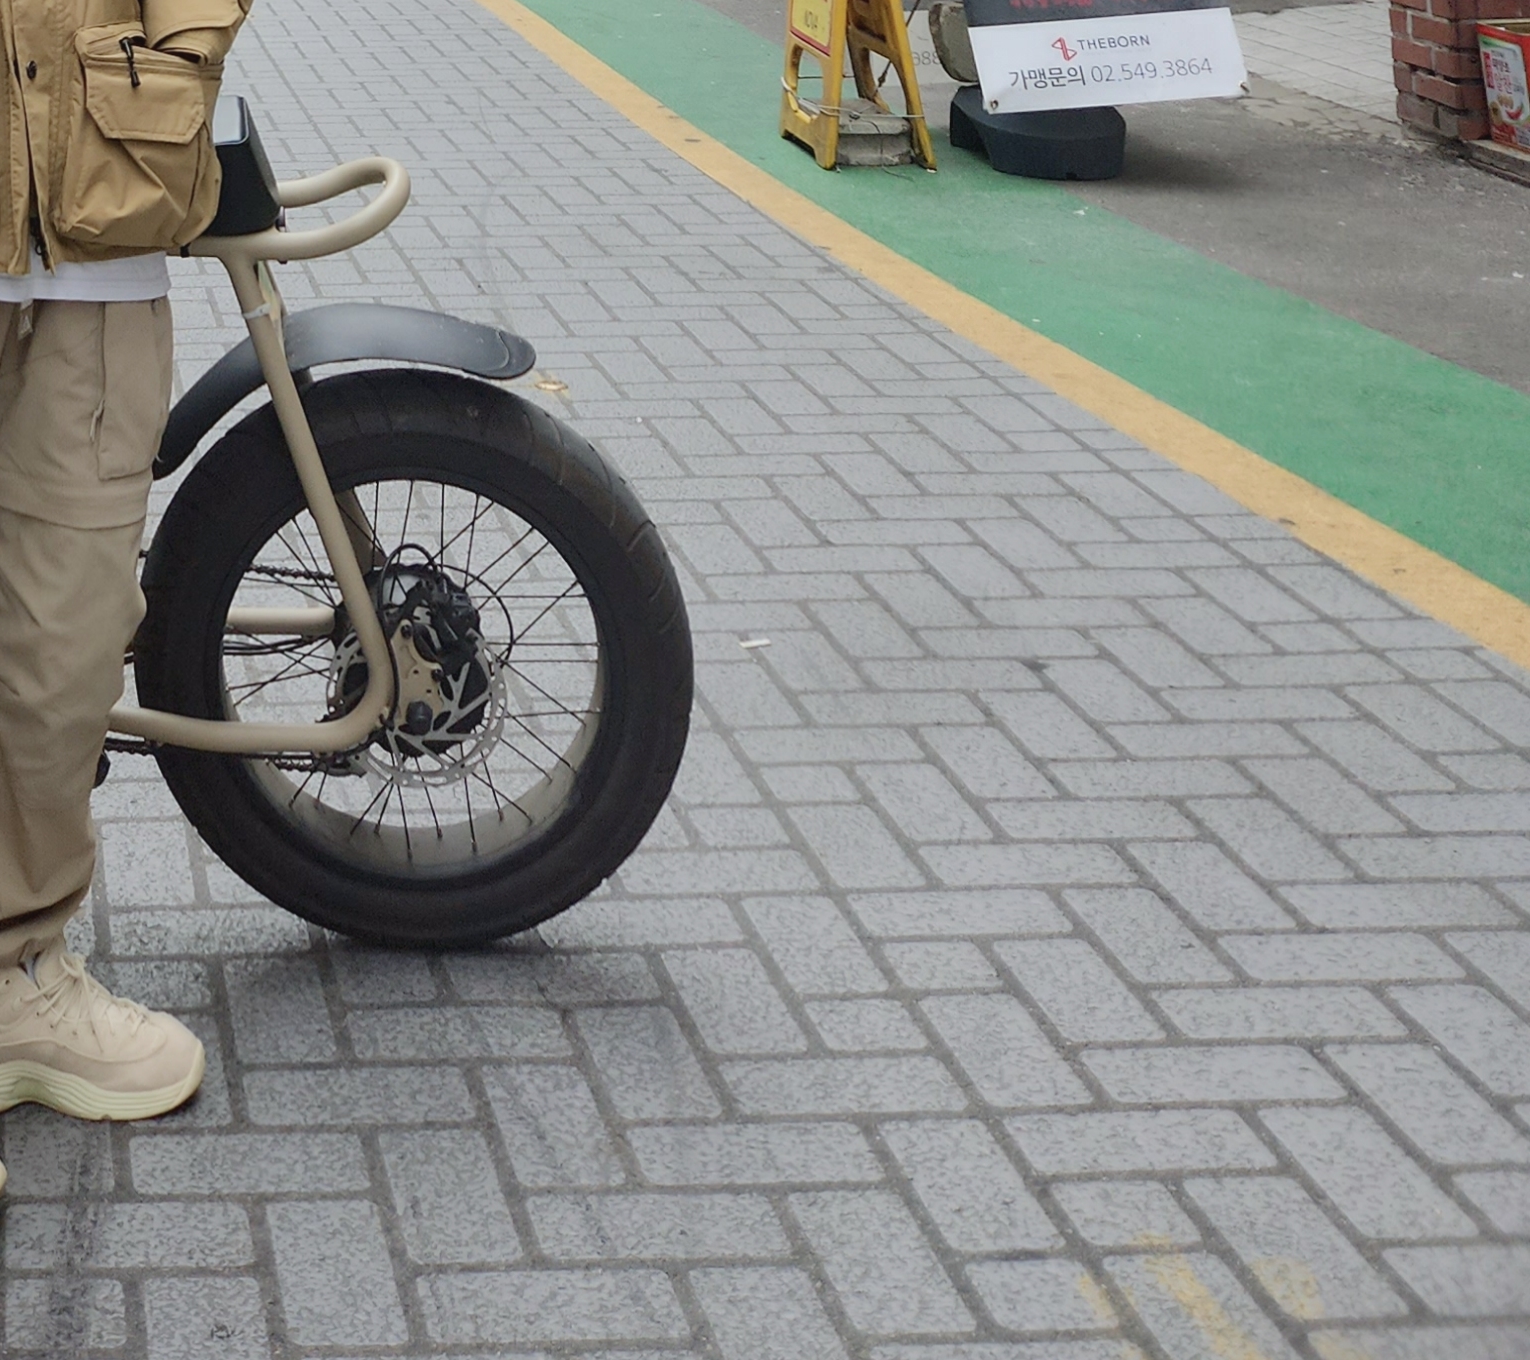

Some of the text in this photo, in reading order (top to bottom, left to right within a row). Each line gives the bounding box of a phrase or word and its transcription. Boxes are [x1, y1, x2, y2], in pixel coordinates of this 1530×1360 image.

[1075, 33, 1152, 52] THEBORN
[1007, 56, 1213, 92] 가맹문의 02.549.3864
